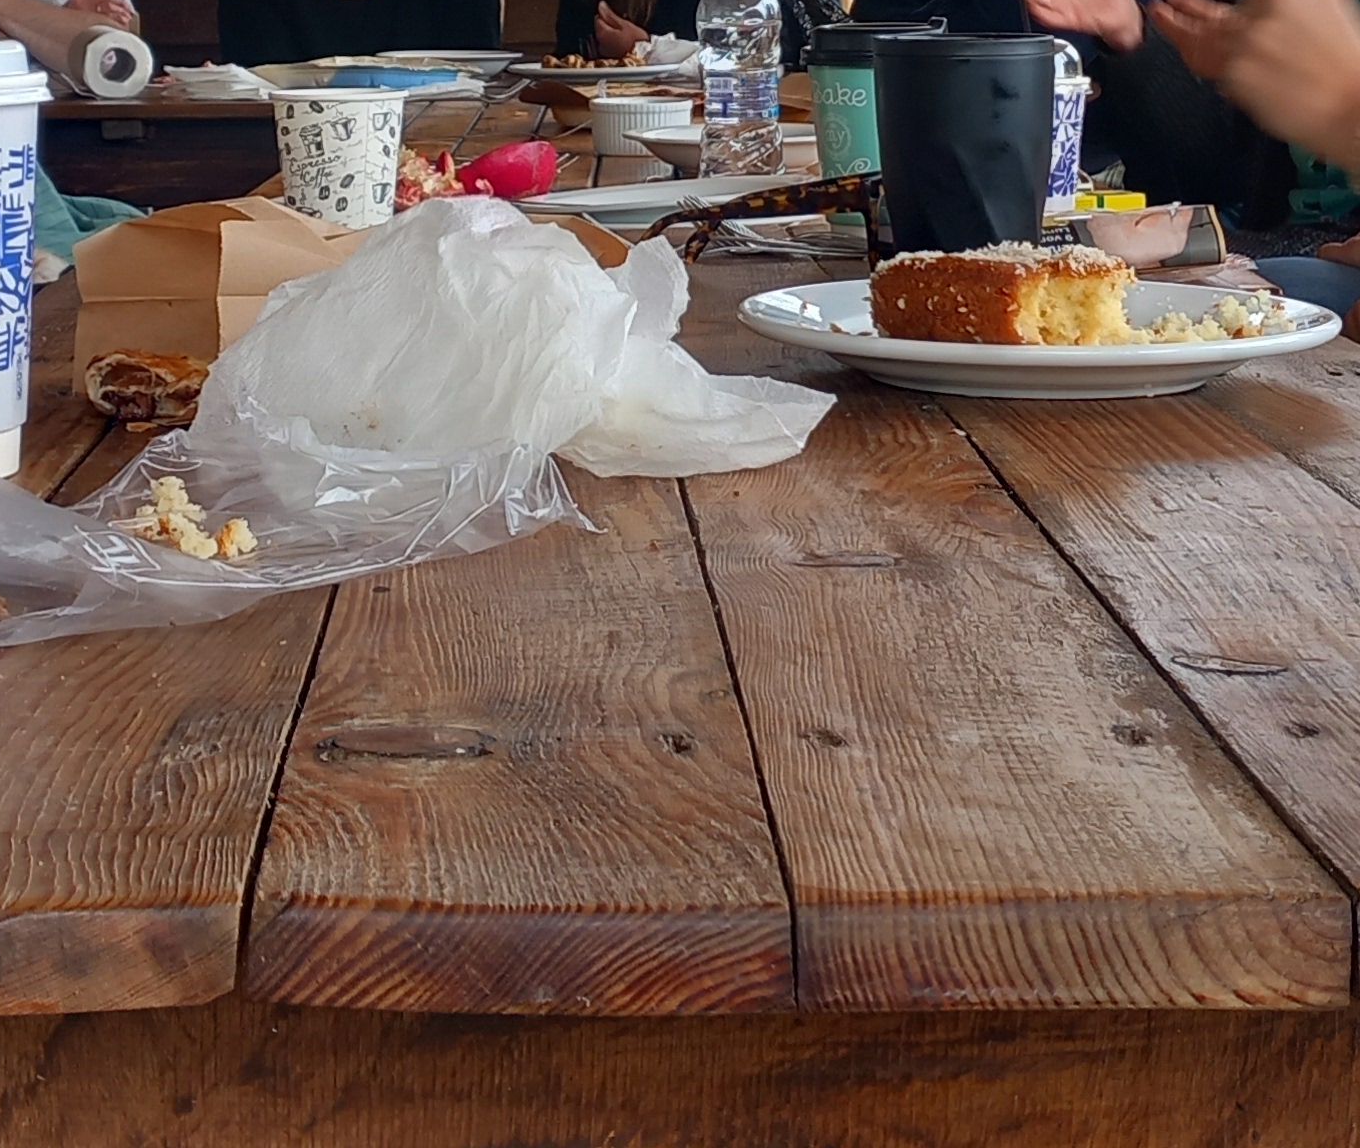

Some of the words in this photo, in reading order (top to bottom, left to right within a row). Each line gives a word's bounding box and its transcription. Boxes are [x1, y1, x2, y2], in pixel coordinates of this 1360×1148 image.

[813, 81, 868, 107] Bake
[289, 155, 342, 180] Espresso
[303, 166, 335, 189] Coffee
